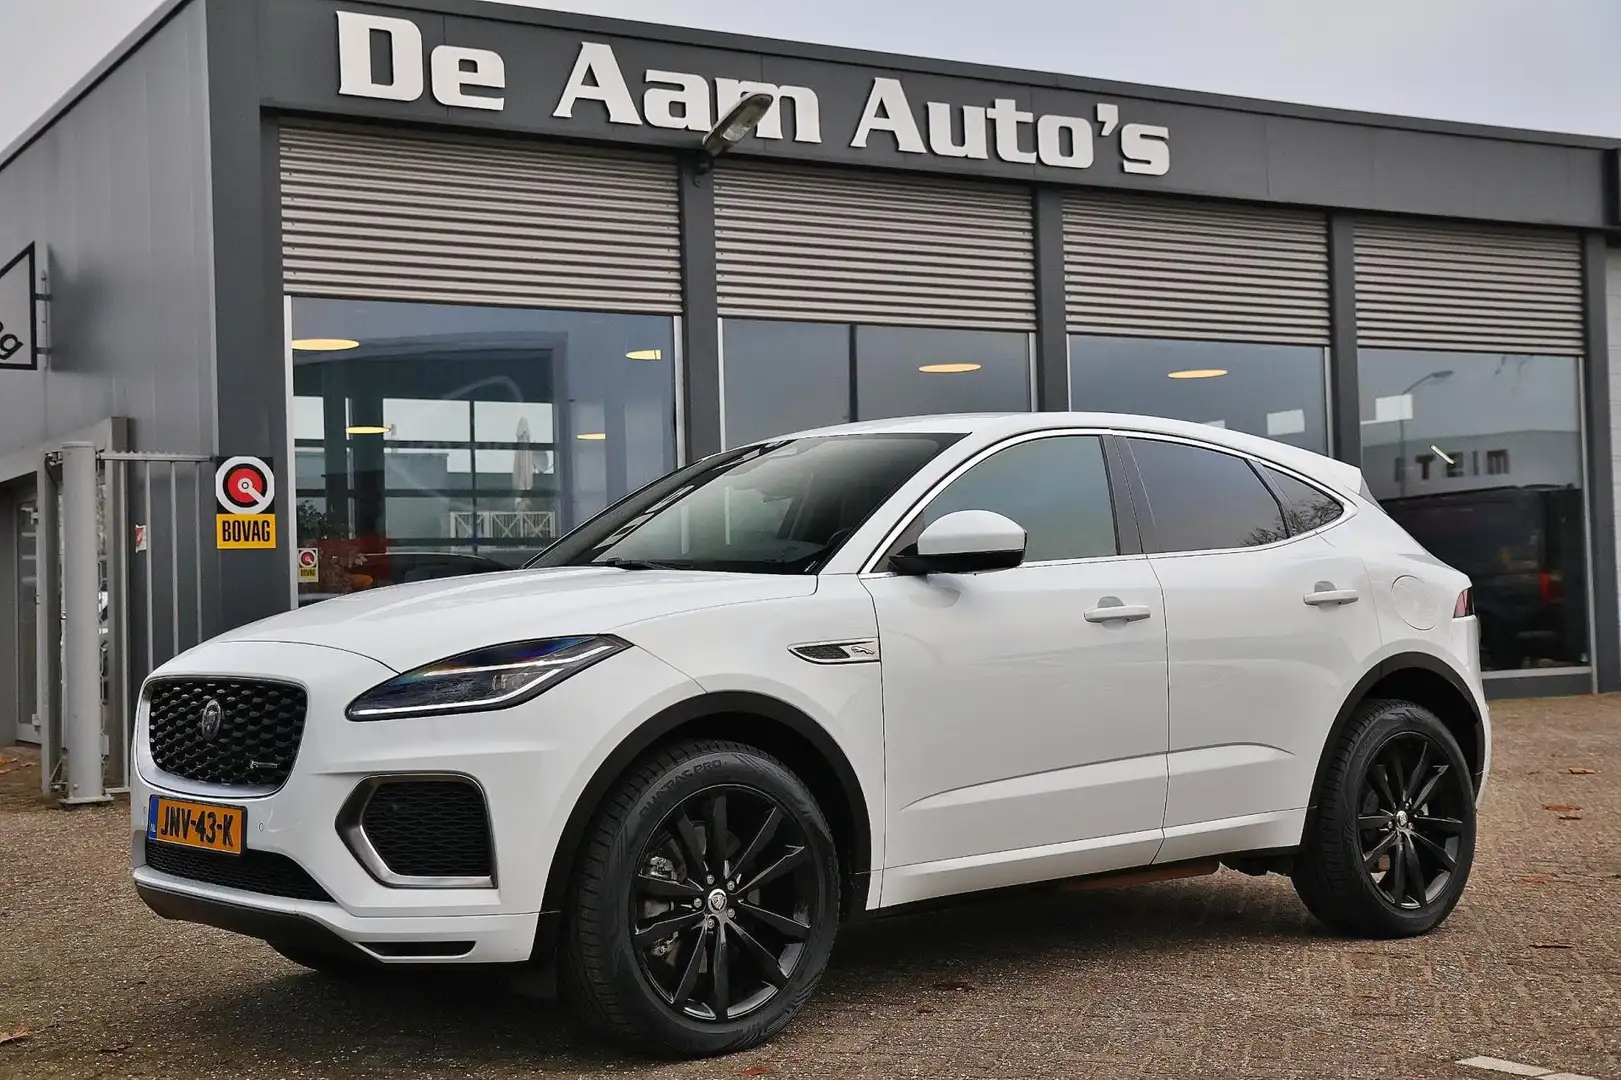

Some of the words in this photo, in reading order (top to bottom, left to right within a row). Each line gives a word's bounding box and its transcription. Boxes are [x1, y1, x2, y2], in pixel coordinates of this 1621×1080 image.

[336, 10, 506, 111] De
[552, 41, 822, 144] Aam
[849, 76, 1170, 176] Auto's
[222, 520, 271, 542] BOVAG
[300, 568, 316, 577] BOVAG
[160, 805, 234, 847] JNV-43-K
